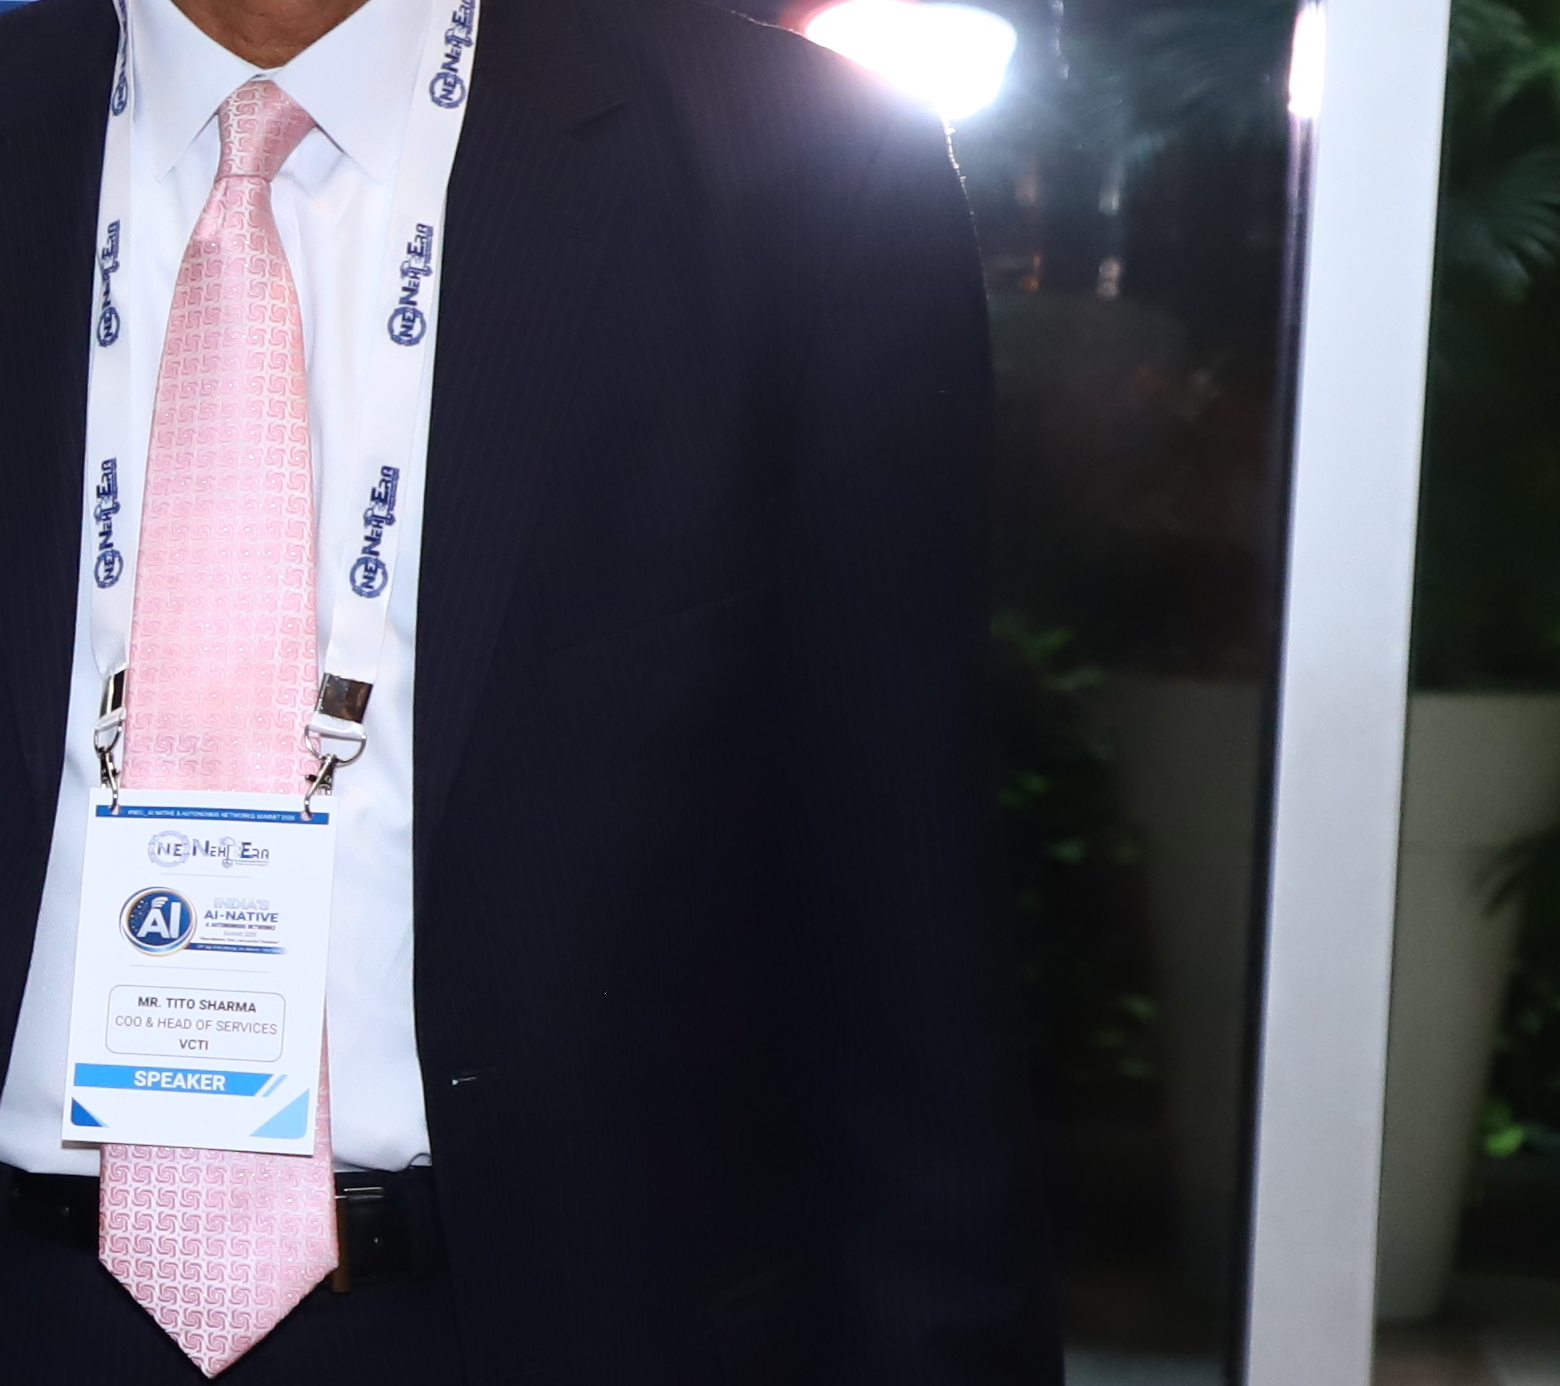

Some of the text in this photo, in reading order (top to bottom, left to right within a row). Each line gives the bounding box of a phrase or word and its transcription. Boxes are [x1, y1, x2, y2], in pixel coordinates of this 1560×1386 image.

[136, 901, 279, 939] AI AI-NATIVE
[137, 996, 257, 1013] MR. TITO SHARMA
[115, 1015, 278, 1035] COO & HEAD OF SERVICES
[179, 1038, 209, 1051] VCTI
[133, 1069, 227, 1092] SPEAKER
